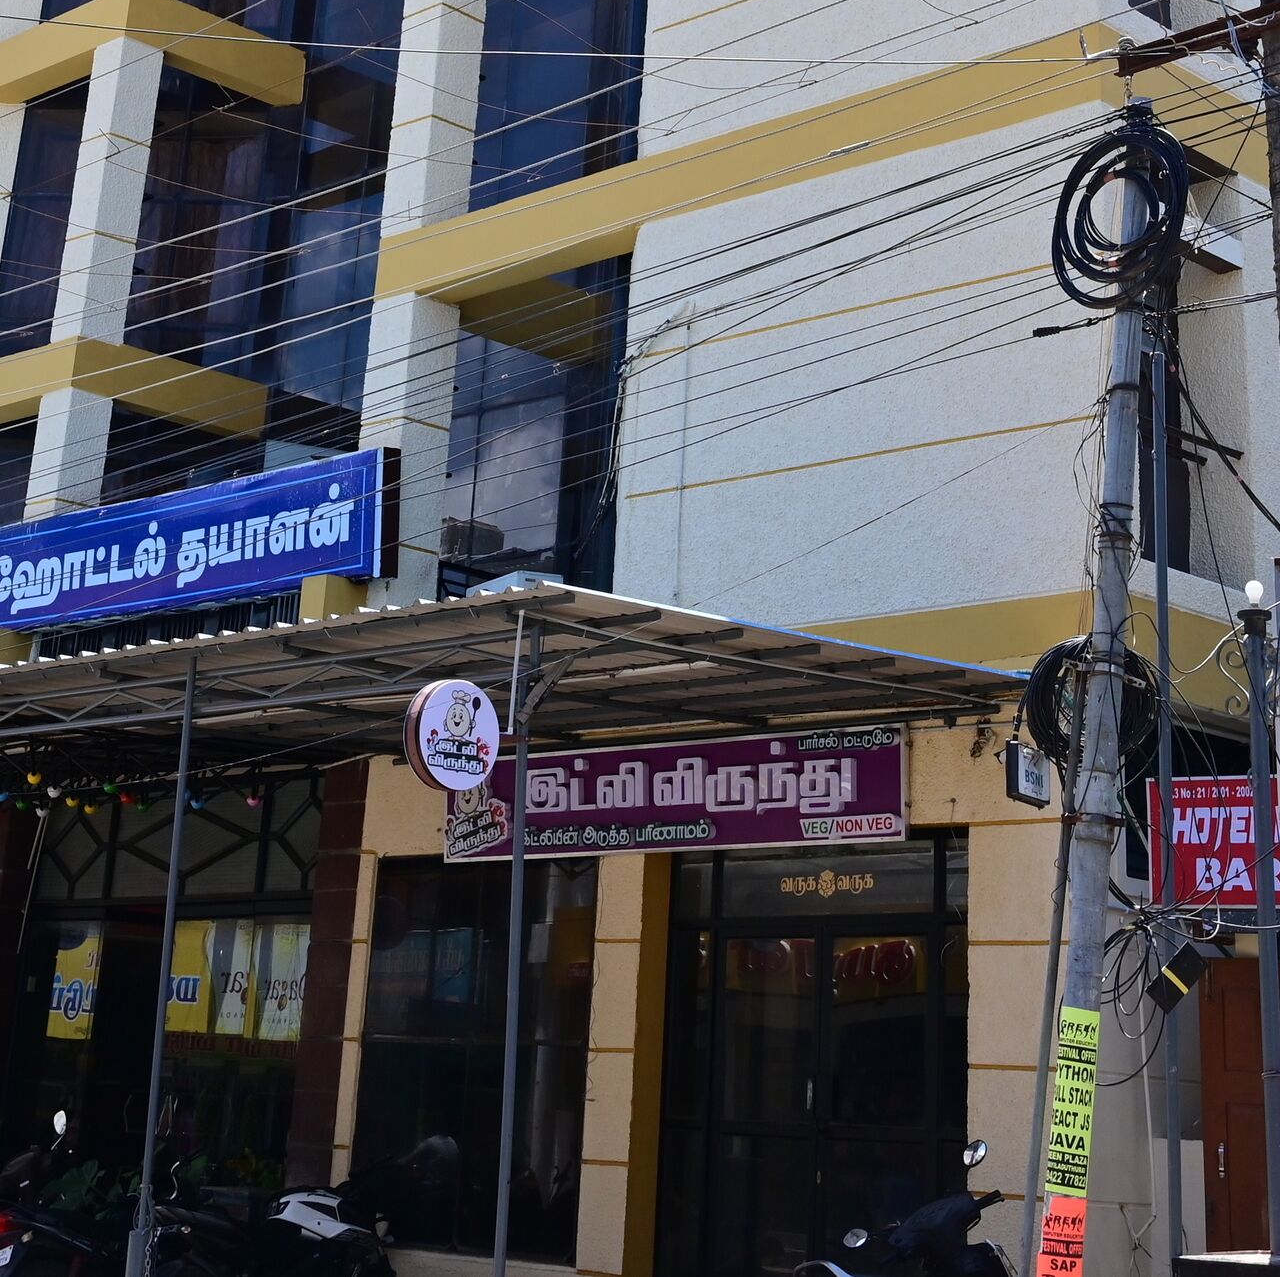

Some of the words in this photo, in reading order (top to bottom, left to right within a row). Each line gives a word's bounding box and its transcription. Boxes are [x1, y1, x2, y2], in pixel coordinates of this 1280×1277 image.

[177, 483, 354, 588] தயாளன்
[436, 740, 478, 757] இட்லி
[798, 734, 839, 751] பார்சல்
[843, 730, 893, 749] மட்டுமே
[429, 755, 484, 774] விருந்து
[526, 757, 648, 814] இட்லி
[653, 741, 857, 816] விருந்து
[454, 811, 492, 838] இட்லி
[582, 823, 631, 846] அடுத்த
[636, 819, 710, 842] பரிணாமம்
[867, 816, 893, 832] VEG
[450, 825, 501, 856] விருந்து
[781, 876, 817, 897] வருக
[837, 873, 874, 894] வருக
[1069, 1086, 1093, 1107] STACK
[1080, 1113, 1090, 1131] JS
[1050, 1131, 1086, 1152] JAVA
[1050, 1259, 1077, 1272] SAP
